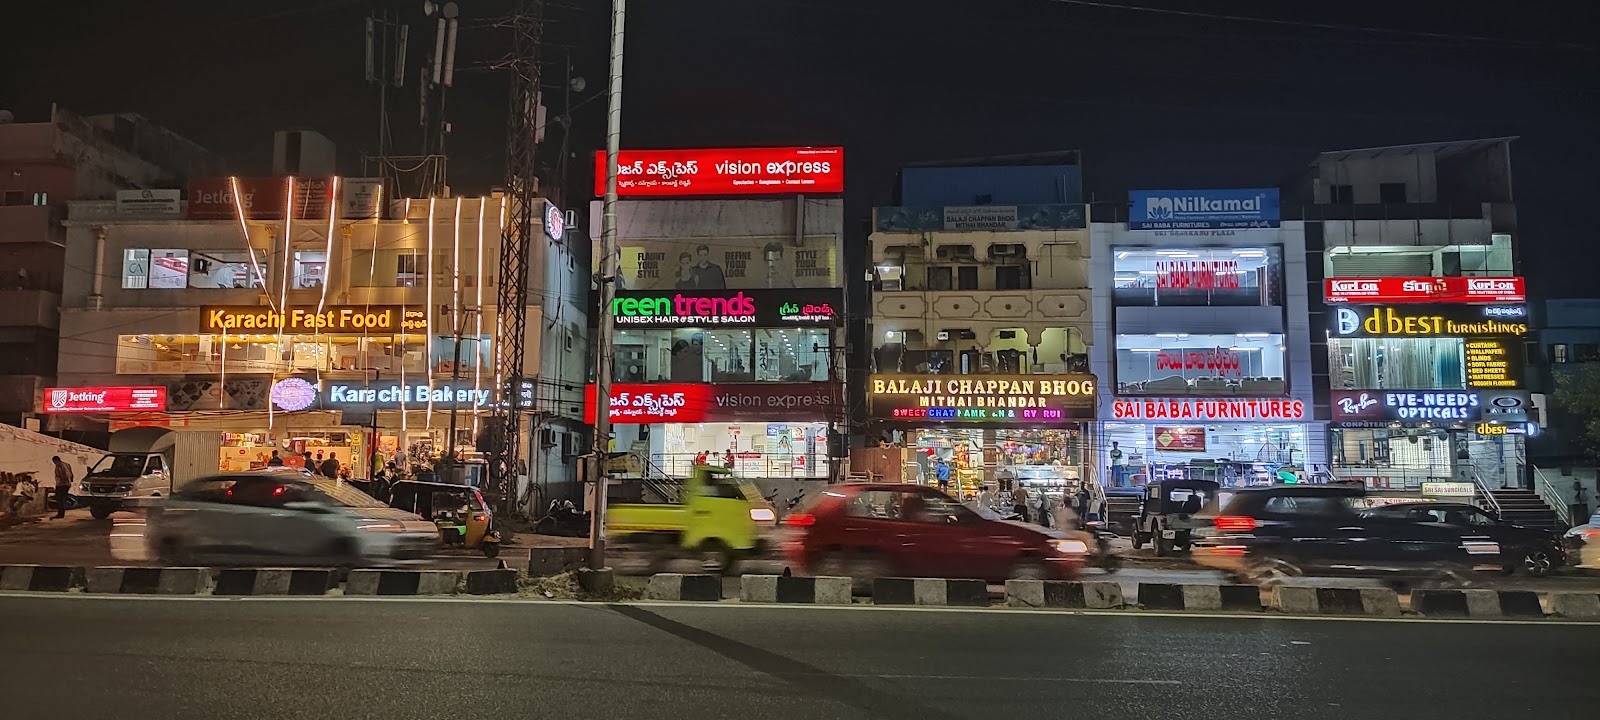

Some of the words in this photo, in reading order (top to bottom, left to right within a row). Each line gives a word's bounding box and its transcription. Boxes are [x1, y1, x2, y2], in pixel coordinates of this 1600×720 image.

[617, 161, 643, 175] జన్
[715, 160, 761, 175] vision
[766, 160, 831, 177] express
[1174, 196, 1261, 212] Nilkamal
[637, 252, 666, 261] FLAUNT
[725, 251, 751, 260] DEFINE
[795, 250, 818, 259] STYLE
[637, 261, 659, 270] YOUR
[725, 260, 747, 269] YOUR
[795, 259, 817, 268] YOUR
[637, 269, 660, 279] STYLE
[725, 268, 746, 278] LOOK
[795, 267, 831, 277] ATTITUDE
[1155, 260, 1168, 288] SAI
[1170, 260, 1190, 288] BABA
[1191, 260, 1239, 289] FURNITURES
[1467, 278, 1516, 290] Kurl-on
[613, 297, 671, 316] reen
[674, 291, 756, 316] trends
[209, 309, 286, 328] Karachi
[291, 309, 335, 328] Fast
[339, 309, 391, 328] Food
[616, 316, 654, 324] UNISEX
[687, 316, 719, 324] STYLE
[873, 379, 942, 395] BALAJI
[947, 379, 1035, 395] CHAPPAN
[1039, 380, 1094, 396] BHOG
[69, 391, 104, 404] Jetking
[330, 385, 411, 403] Karachi
[416, 385, 490, 406] Bakery
[716, 392, 761, 407] vision
[1386, 393, 1479, 407] EYE-NEEDS
[919, 396, 972, 408] MITHAI
[974, 396, 1047, 408] BHANDAR
[1337, 392, 1378, 414] Ray-Ban
[893, 408, 927, 417] SWEET
[928, 408, 955, 417] CHAT
[1007, 408, 1015, 418] &
[1113, 400, 1140, 418] SAI
[1145, 400, 1193, 418] BABA
[1196, 400, 1304, 418] FURNITURES
[1397, 407, 1468, 418] OPTICALS
